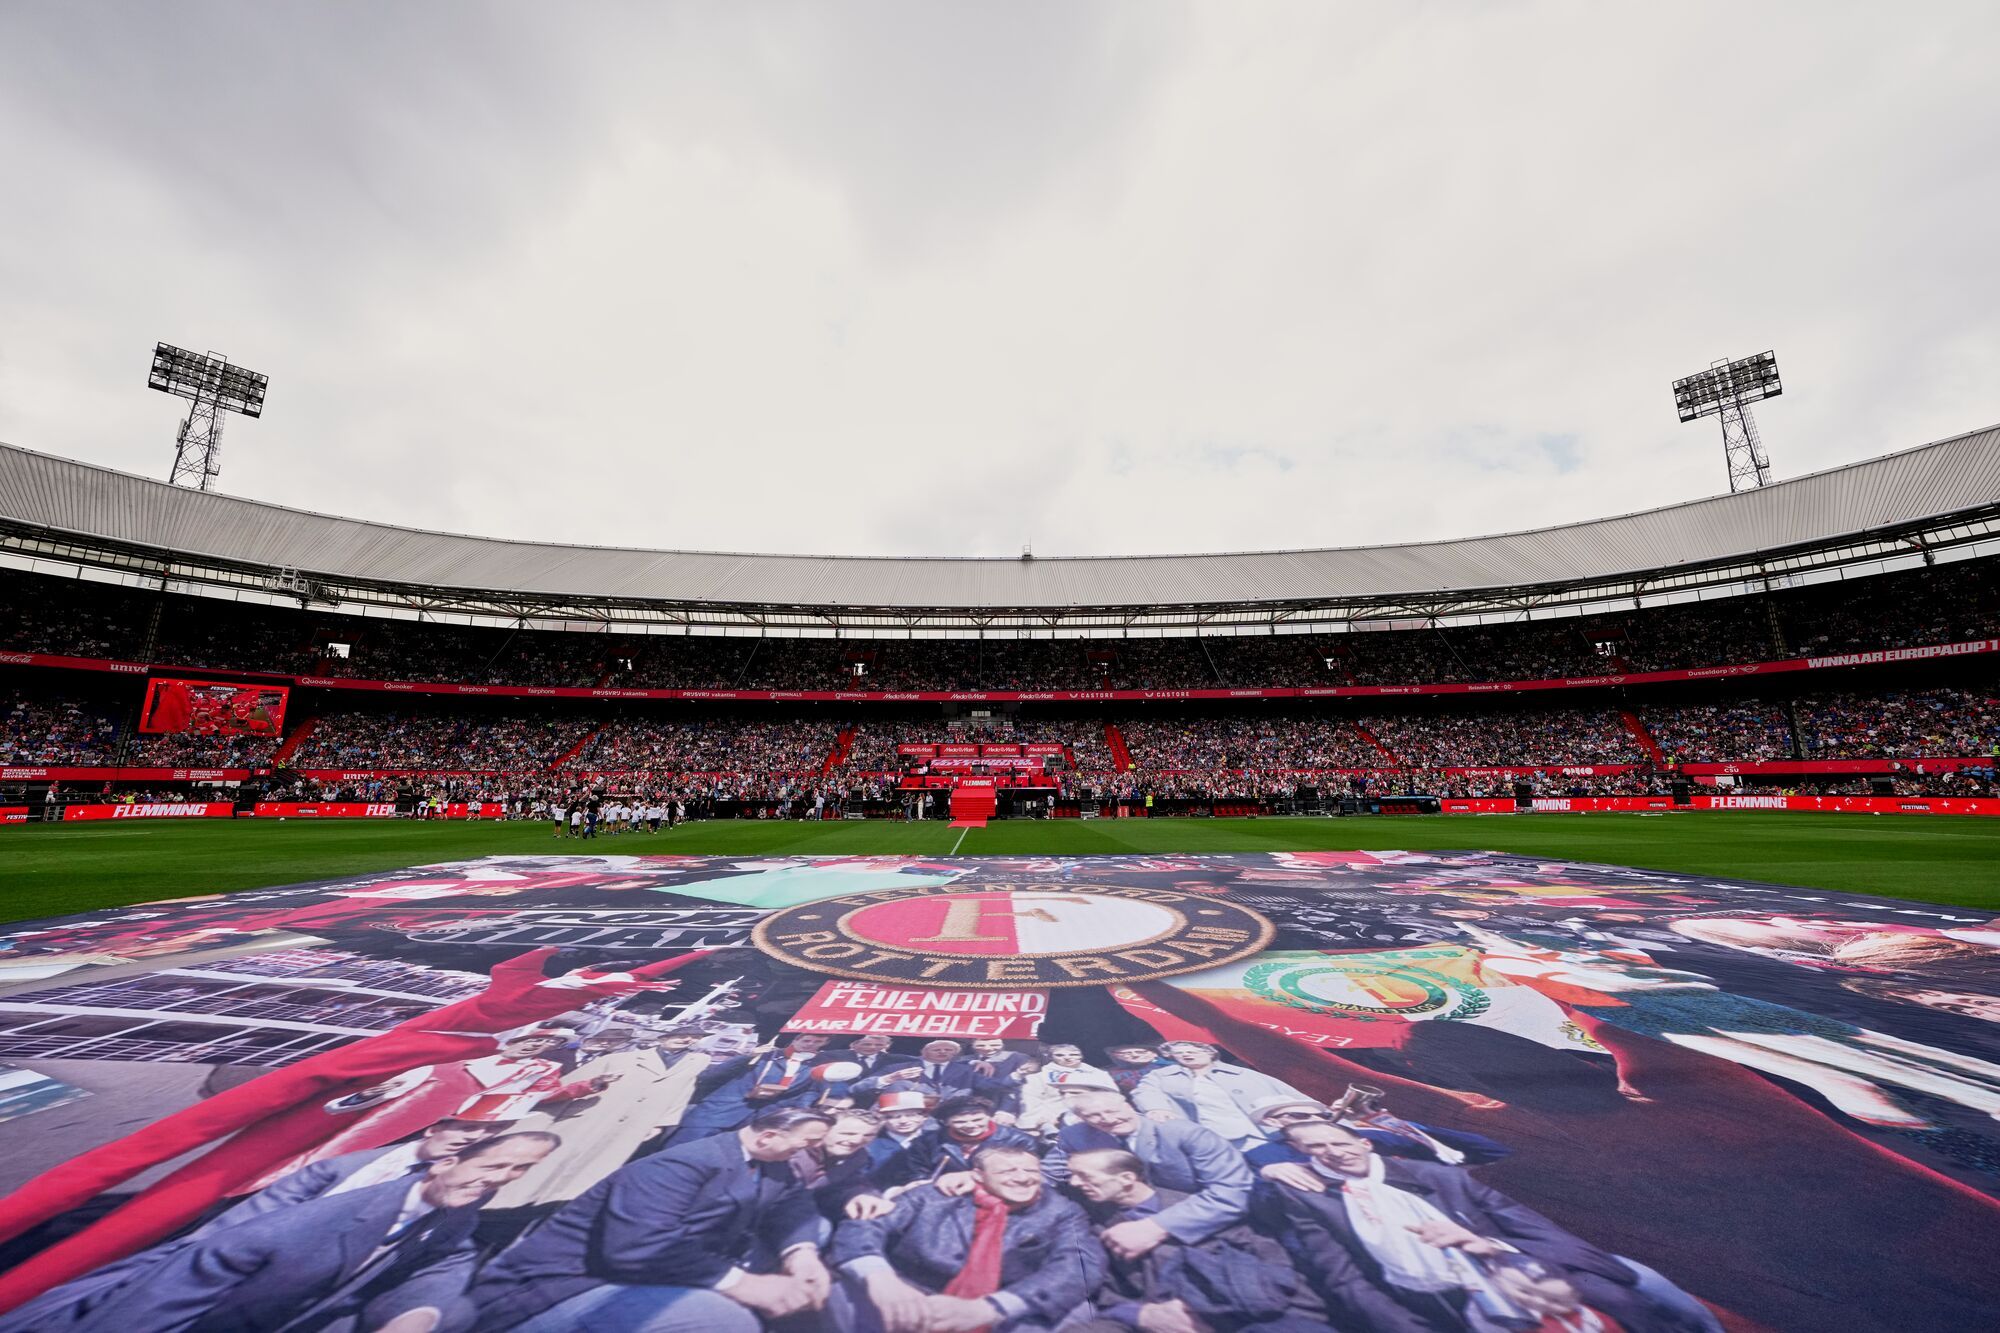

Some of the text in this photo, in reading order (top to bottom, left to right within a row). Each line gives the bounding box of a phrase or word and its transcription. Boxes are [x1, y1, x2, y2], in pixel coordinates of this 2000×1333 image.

[1807, 652, 1884, 669] WINNAAR
[1885, 640, 1986, 662] EUROPACUP
[1688, 668, 1728, 677] Dusseldorp
[301, 677, 335, 685] Quooker
[383, 682, 414, 690] Quooker
[1566, 678, 1600, 686] Dusseldorp
[1710, 796, 1788, 809] FLEMMING
[112, 803, 208, 818] FLEMMING
[830, 884, 1187, 905] FEYENOORD
[777, 925, 1252, 981] ROTTERDAM
